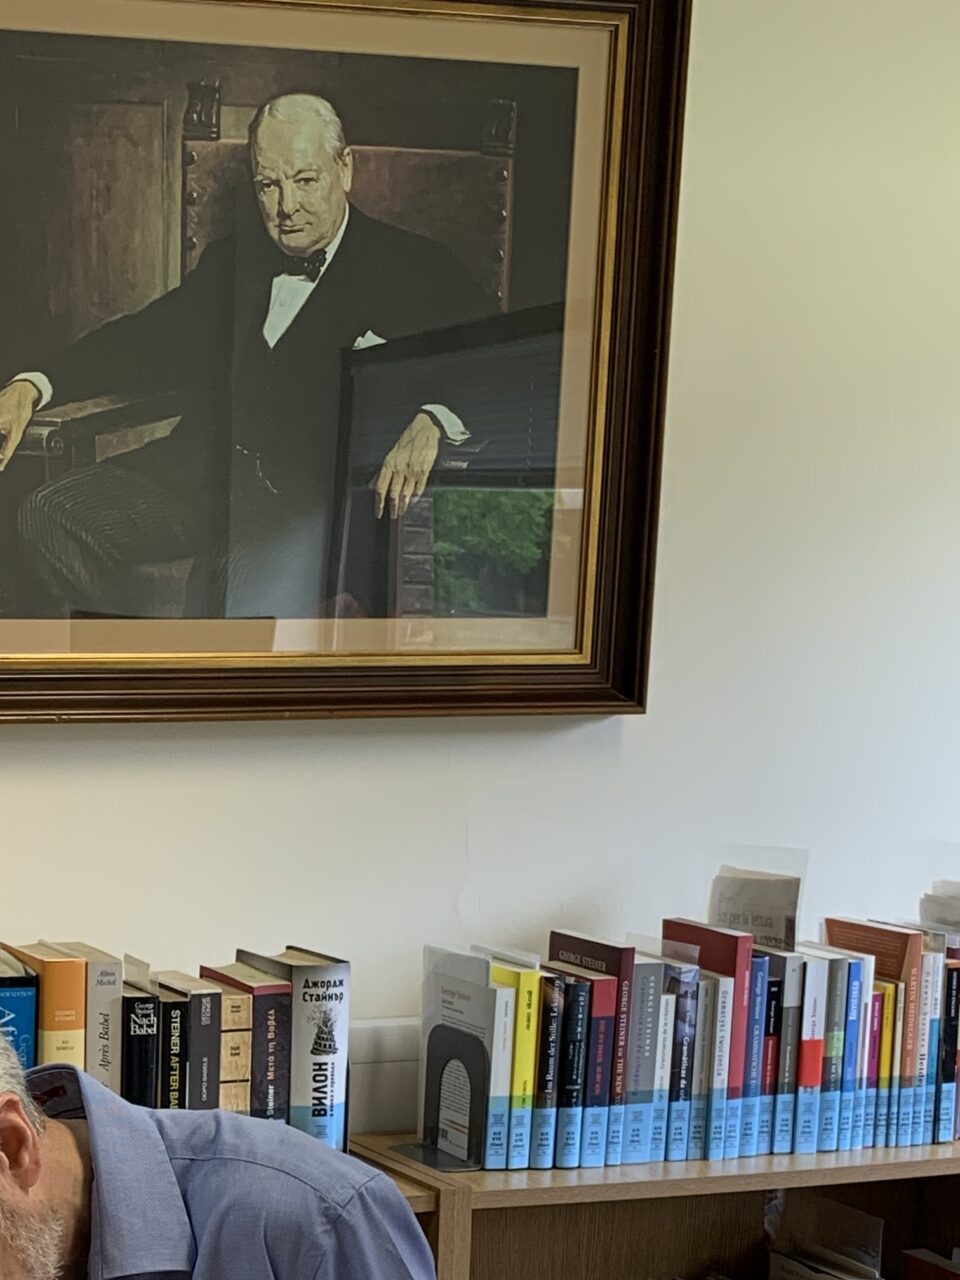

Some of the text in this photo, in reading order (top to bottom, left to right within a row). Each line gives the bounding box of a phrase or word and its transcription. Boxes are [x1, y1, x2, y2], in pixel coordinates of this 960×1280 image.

[559, 951, 606, 971] GEORGE STEINER
[95, 978, 117, 987] Michel
[302, 992, 344, 1004] Стайнър
[303, 978, 344, 992] Джордж
[756, 972, 764, 995] George
[130, 1014, 157, 1025] Nach
[644, 976, 655, 1057] GEORGE STEINER
[719, 991, 728, 1033] Gramatyki
[906, 967, 918, 1051] MARTIN HEIDEGGER
[98, 1013, 114, 1072] Après Babel
[130, 1024, 157, 1035] Babel
[170, 1010, 181, 1054] STEINER
[615, 981, 629, 1094] GEORGE STEINER THE NEW
[548, 1041, 556, 1054] der
[750, 1025, 760, 1079] GRAMMATICHE
[169, 1055, 180, 1090] AFTER
[545, 1056, 554, 1080] Raum
[266, 1085, 276, 1116] Steiner
[312, 1062, 328, 1117] ВИЛОН
